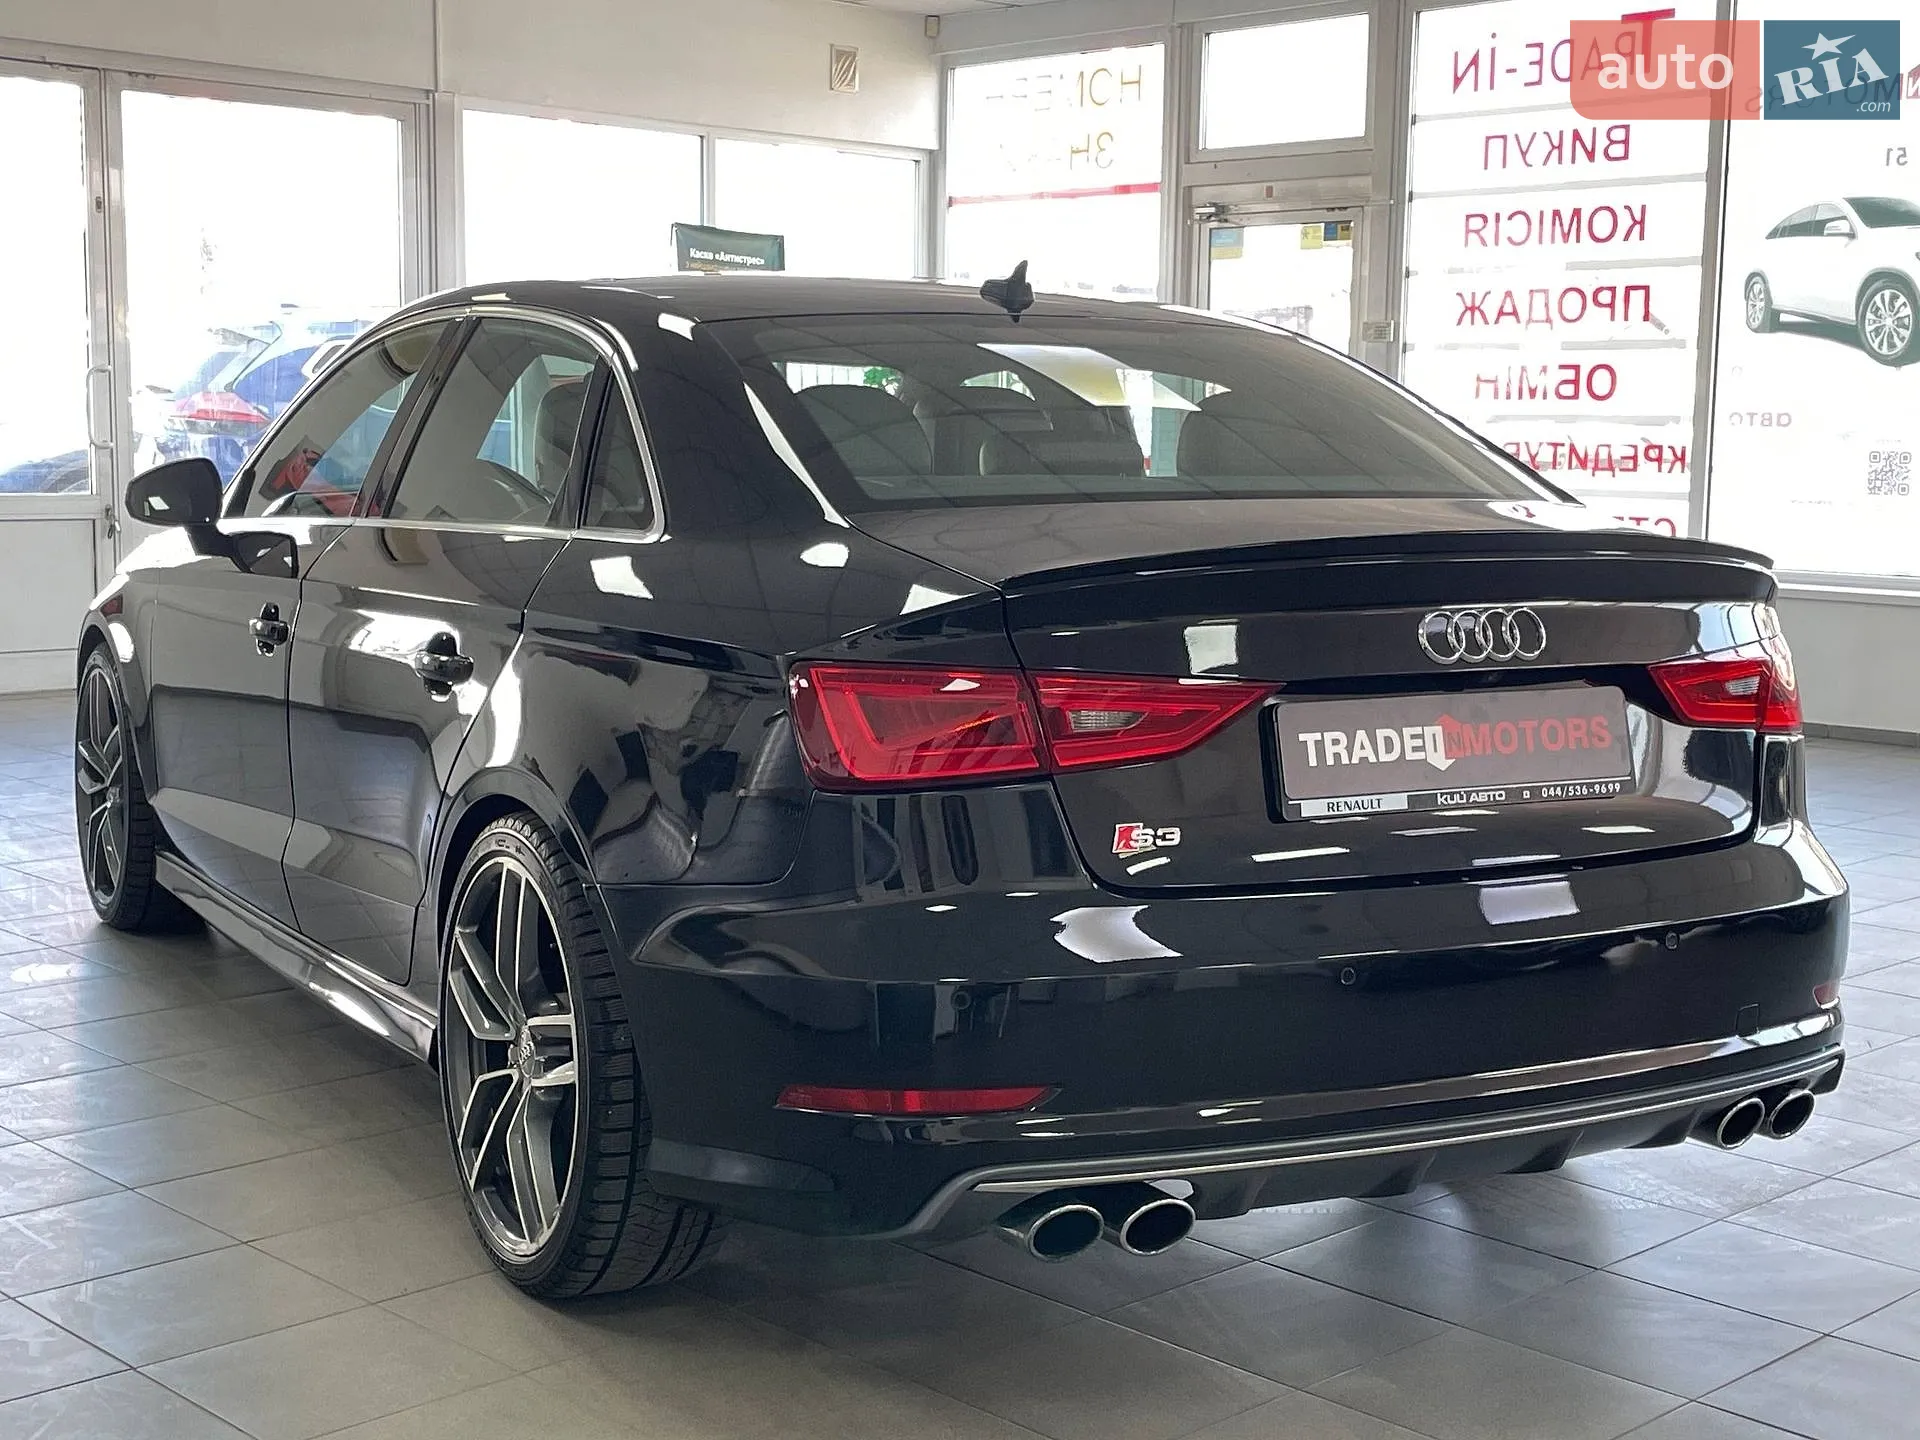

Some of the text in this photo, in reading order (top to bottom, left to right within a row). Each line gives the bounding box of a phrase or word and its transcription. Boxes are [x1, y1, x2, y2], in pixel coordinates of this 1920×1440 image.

[1326, 797, 1384, 813] RENAULT
[1541, 782, 1621, 798] 044/536-9699
[1124, 825, 1181, 849] S3
